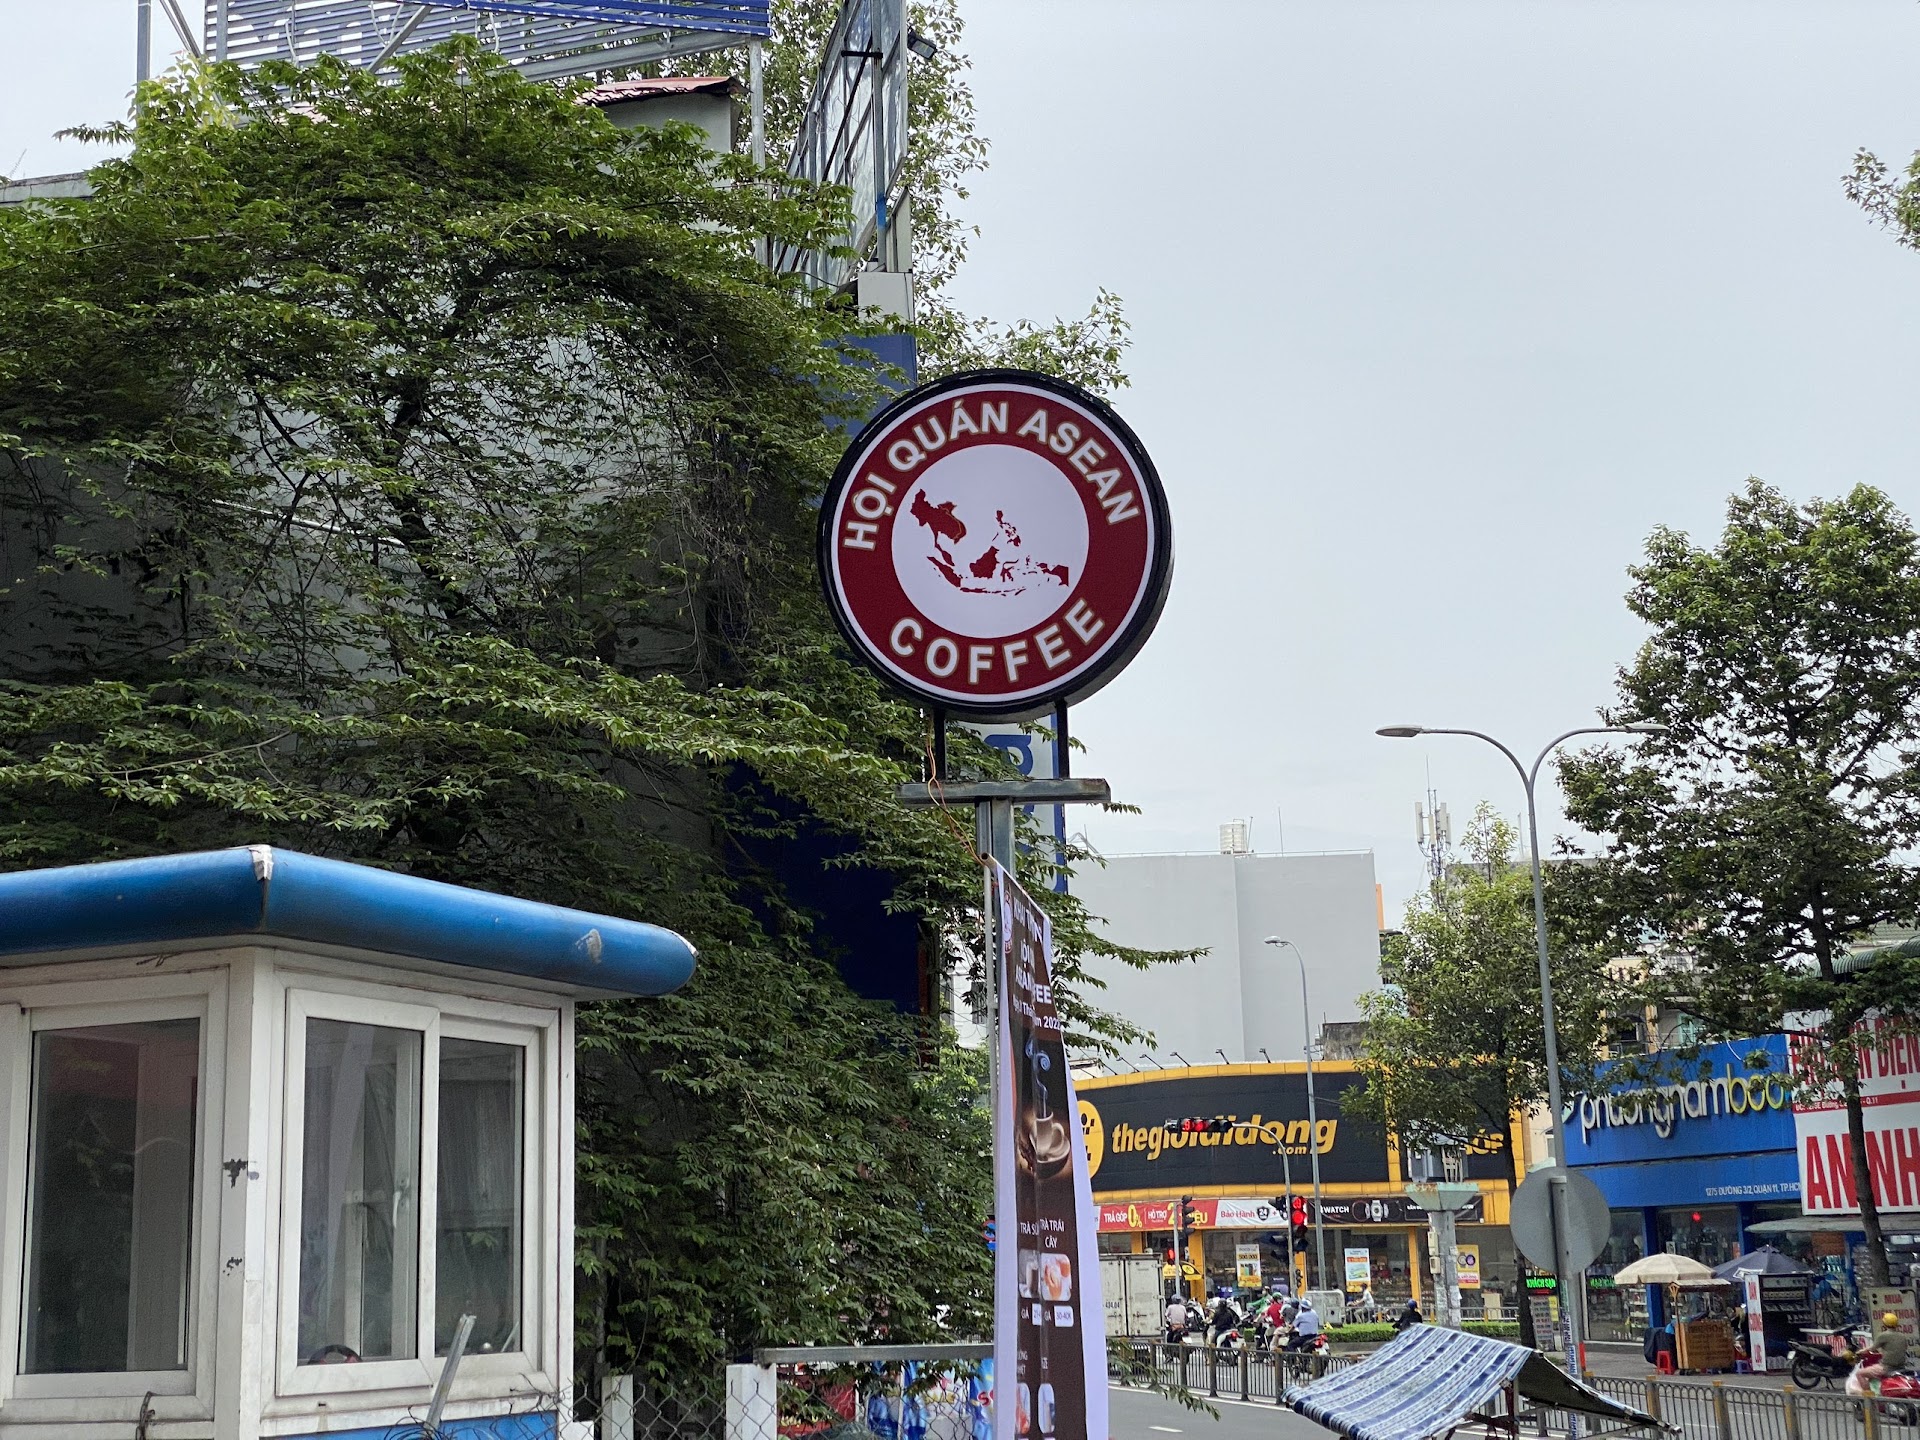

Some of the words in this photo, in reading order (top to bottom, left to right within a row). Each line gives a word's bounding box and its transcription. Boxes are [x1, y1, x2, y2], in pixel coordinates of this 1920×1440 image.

[844, 473, 896, 549] HỘI
[888, 400, 1008, 472] QUÁN
[1017, 409, 1139, 525] ASEAN
[890, 598, 1105, 685] COFFEE
[1116, 1211, 1127, 1223] GÓP
[1127, 1204, 1142, 1228] 0%
